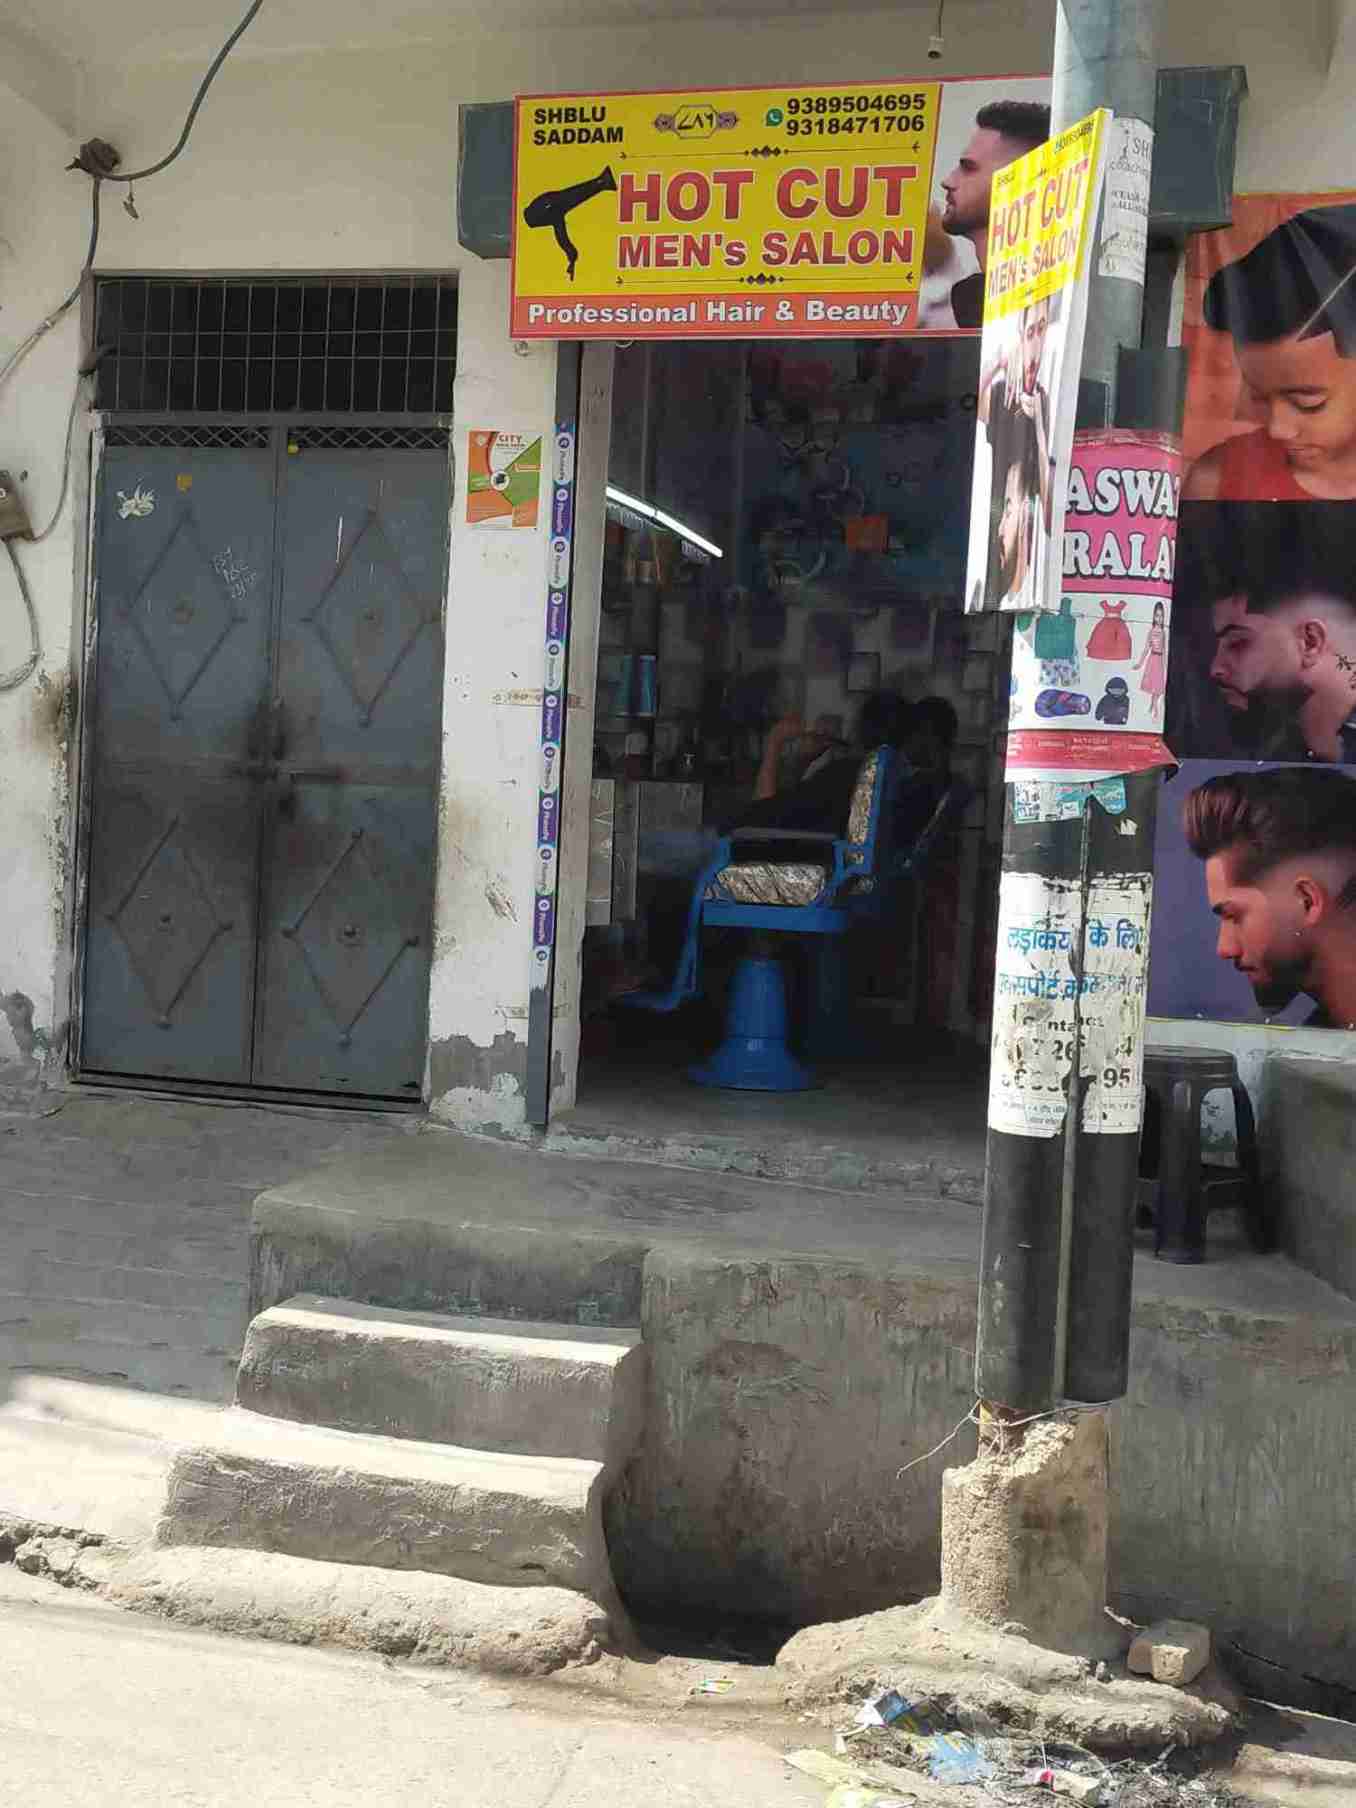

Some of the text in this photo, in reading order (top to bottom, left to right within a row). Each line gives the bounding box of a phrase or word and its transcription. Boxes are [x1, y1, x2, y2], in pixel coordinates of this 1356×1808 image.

[533, 106, 606, 126] SHBLU
[787, 93, 926, 115] 9389504695
[533, 126, 623, 146] SADDAM
[786, 114, 925, 136] 9318471706
[618, 163, 919, 223] HOT CUT
[991, 158, 1089, 256] HOT CUT
[618, 229, 913, 269] MEN's SALON
[1031, 225, 1080, 276] SALON
[528, 299, 908, 325] Professional Hair & Beauty
